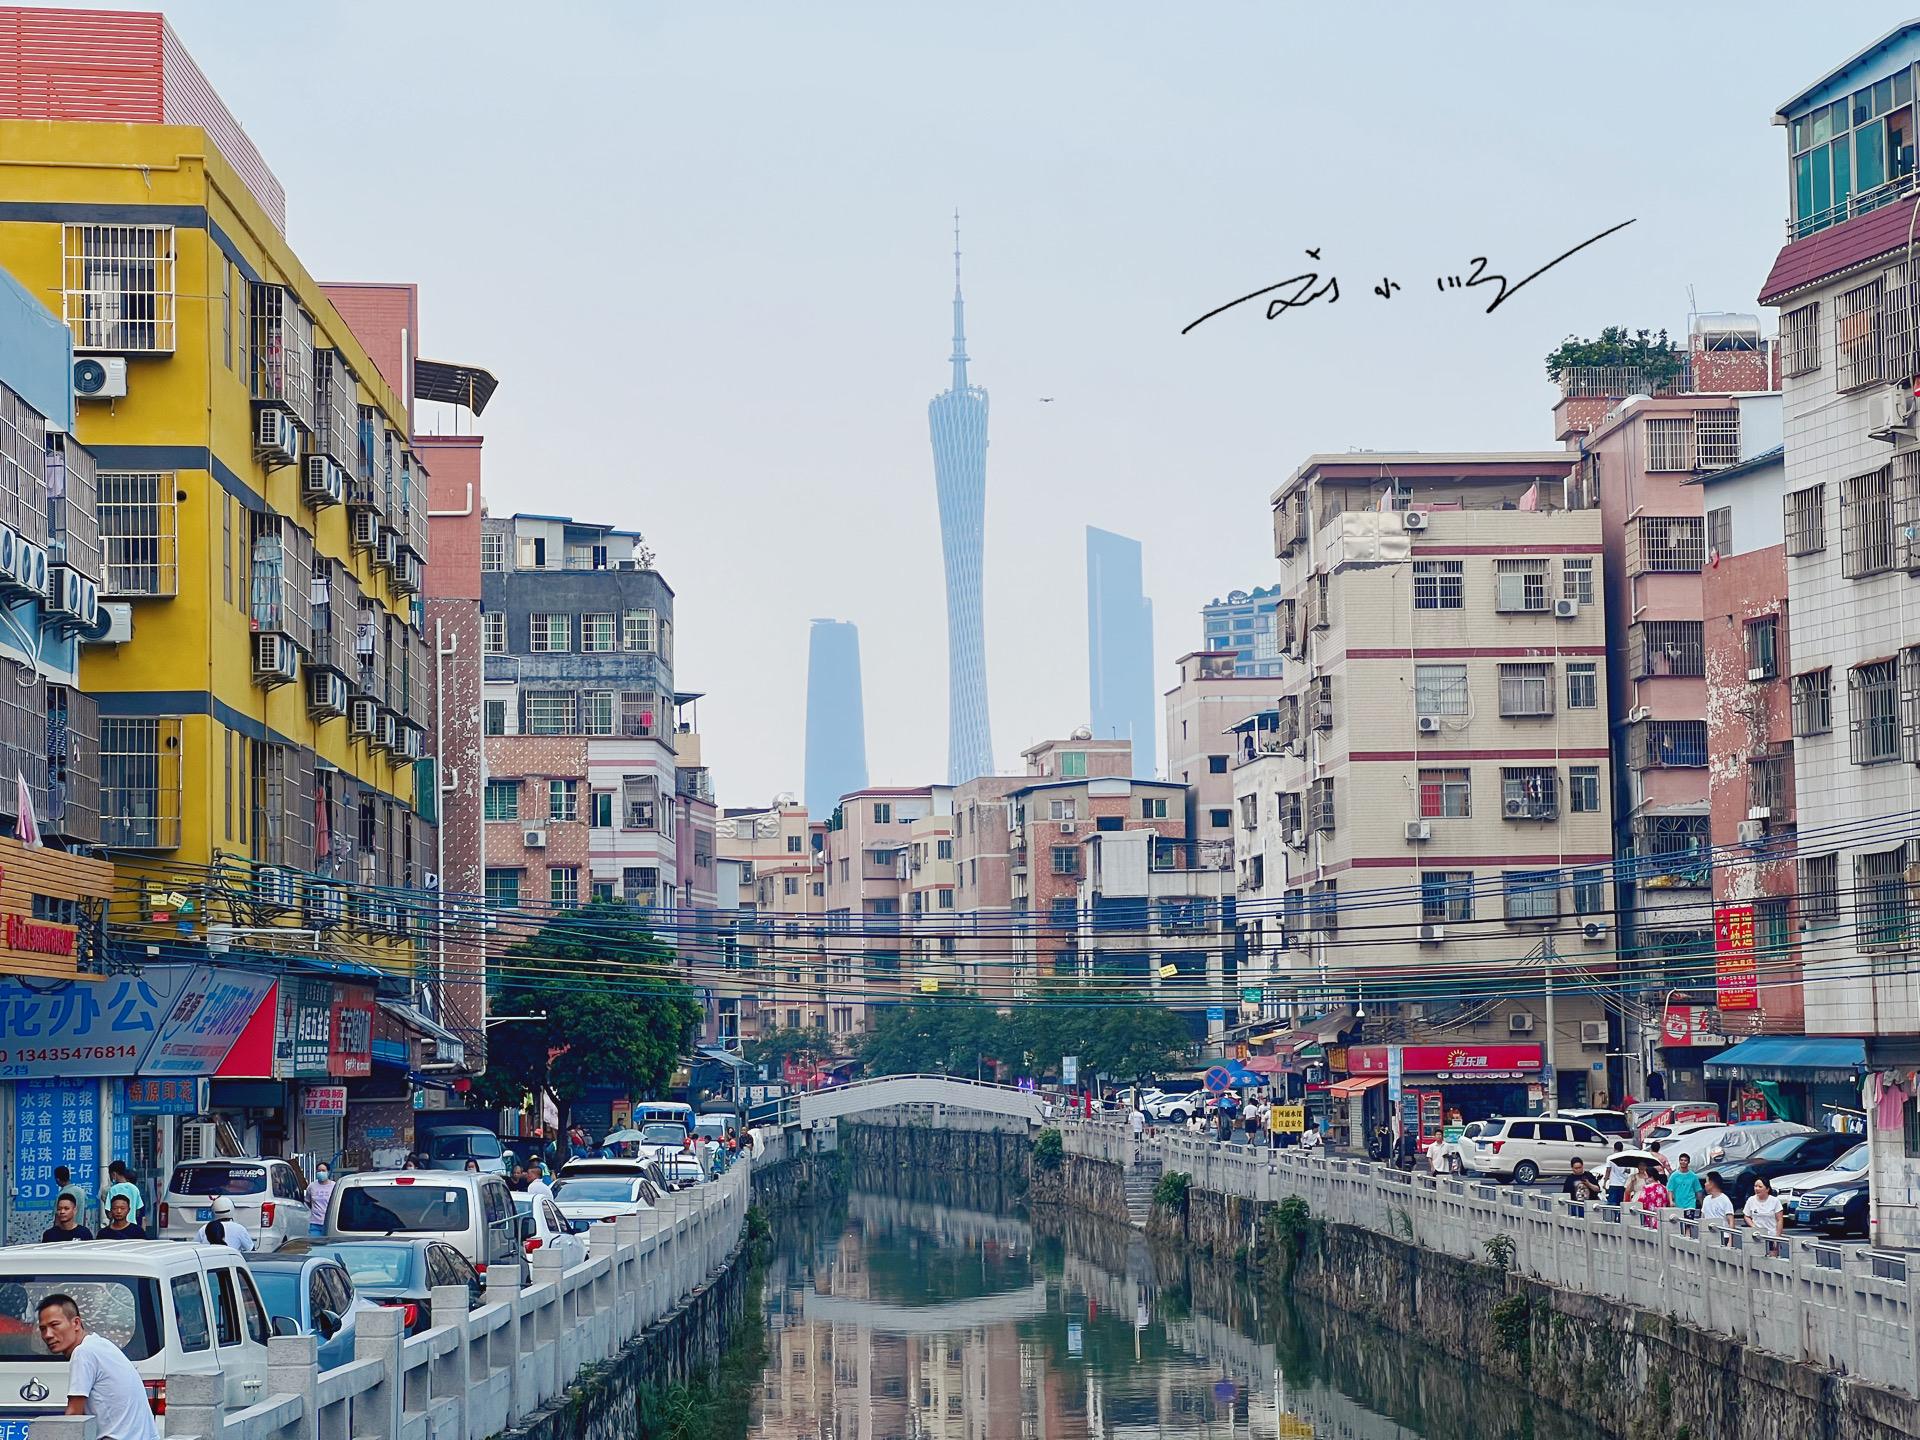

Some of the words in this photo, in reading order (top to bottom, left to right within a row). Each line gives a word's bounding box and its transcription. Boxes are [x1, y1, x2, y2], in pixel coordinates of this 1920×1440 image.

[16, 1045, 136, 1062] 13435476814
[21, 1093, 52, 1108] 水浆
[62, 1092, 93, 1107] 胶浆
[21, 1111, 52, 1126] 烫金
[62, 1110, 93, 1125] 烫银
[1279, 1120, 1302, 1128] 注意安全
[21, 1129, 52, 1144] 厚板
[62, 1128, 93, 1143] 拉胶
[21, 1147, 52, 1162] 粘珠
[62, 1146, 93, 1161] 油墨
[21, 1165, 52, 1180] 拔印
[21, 1184, 50, 1198] 3D
